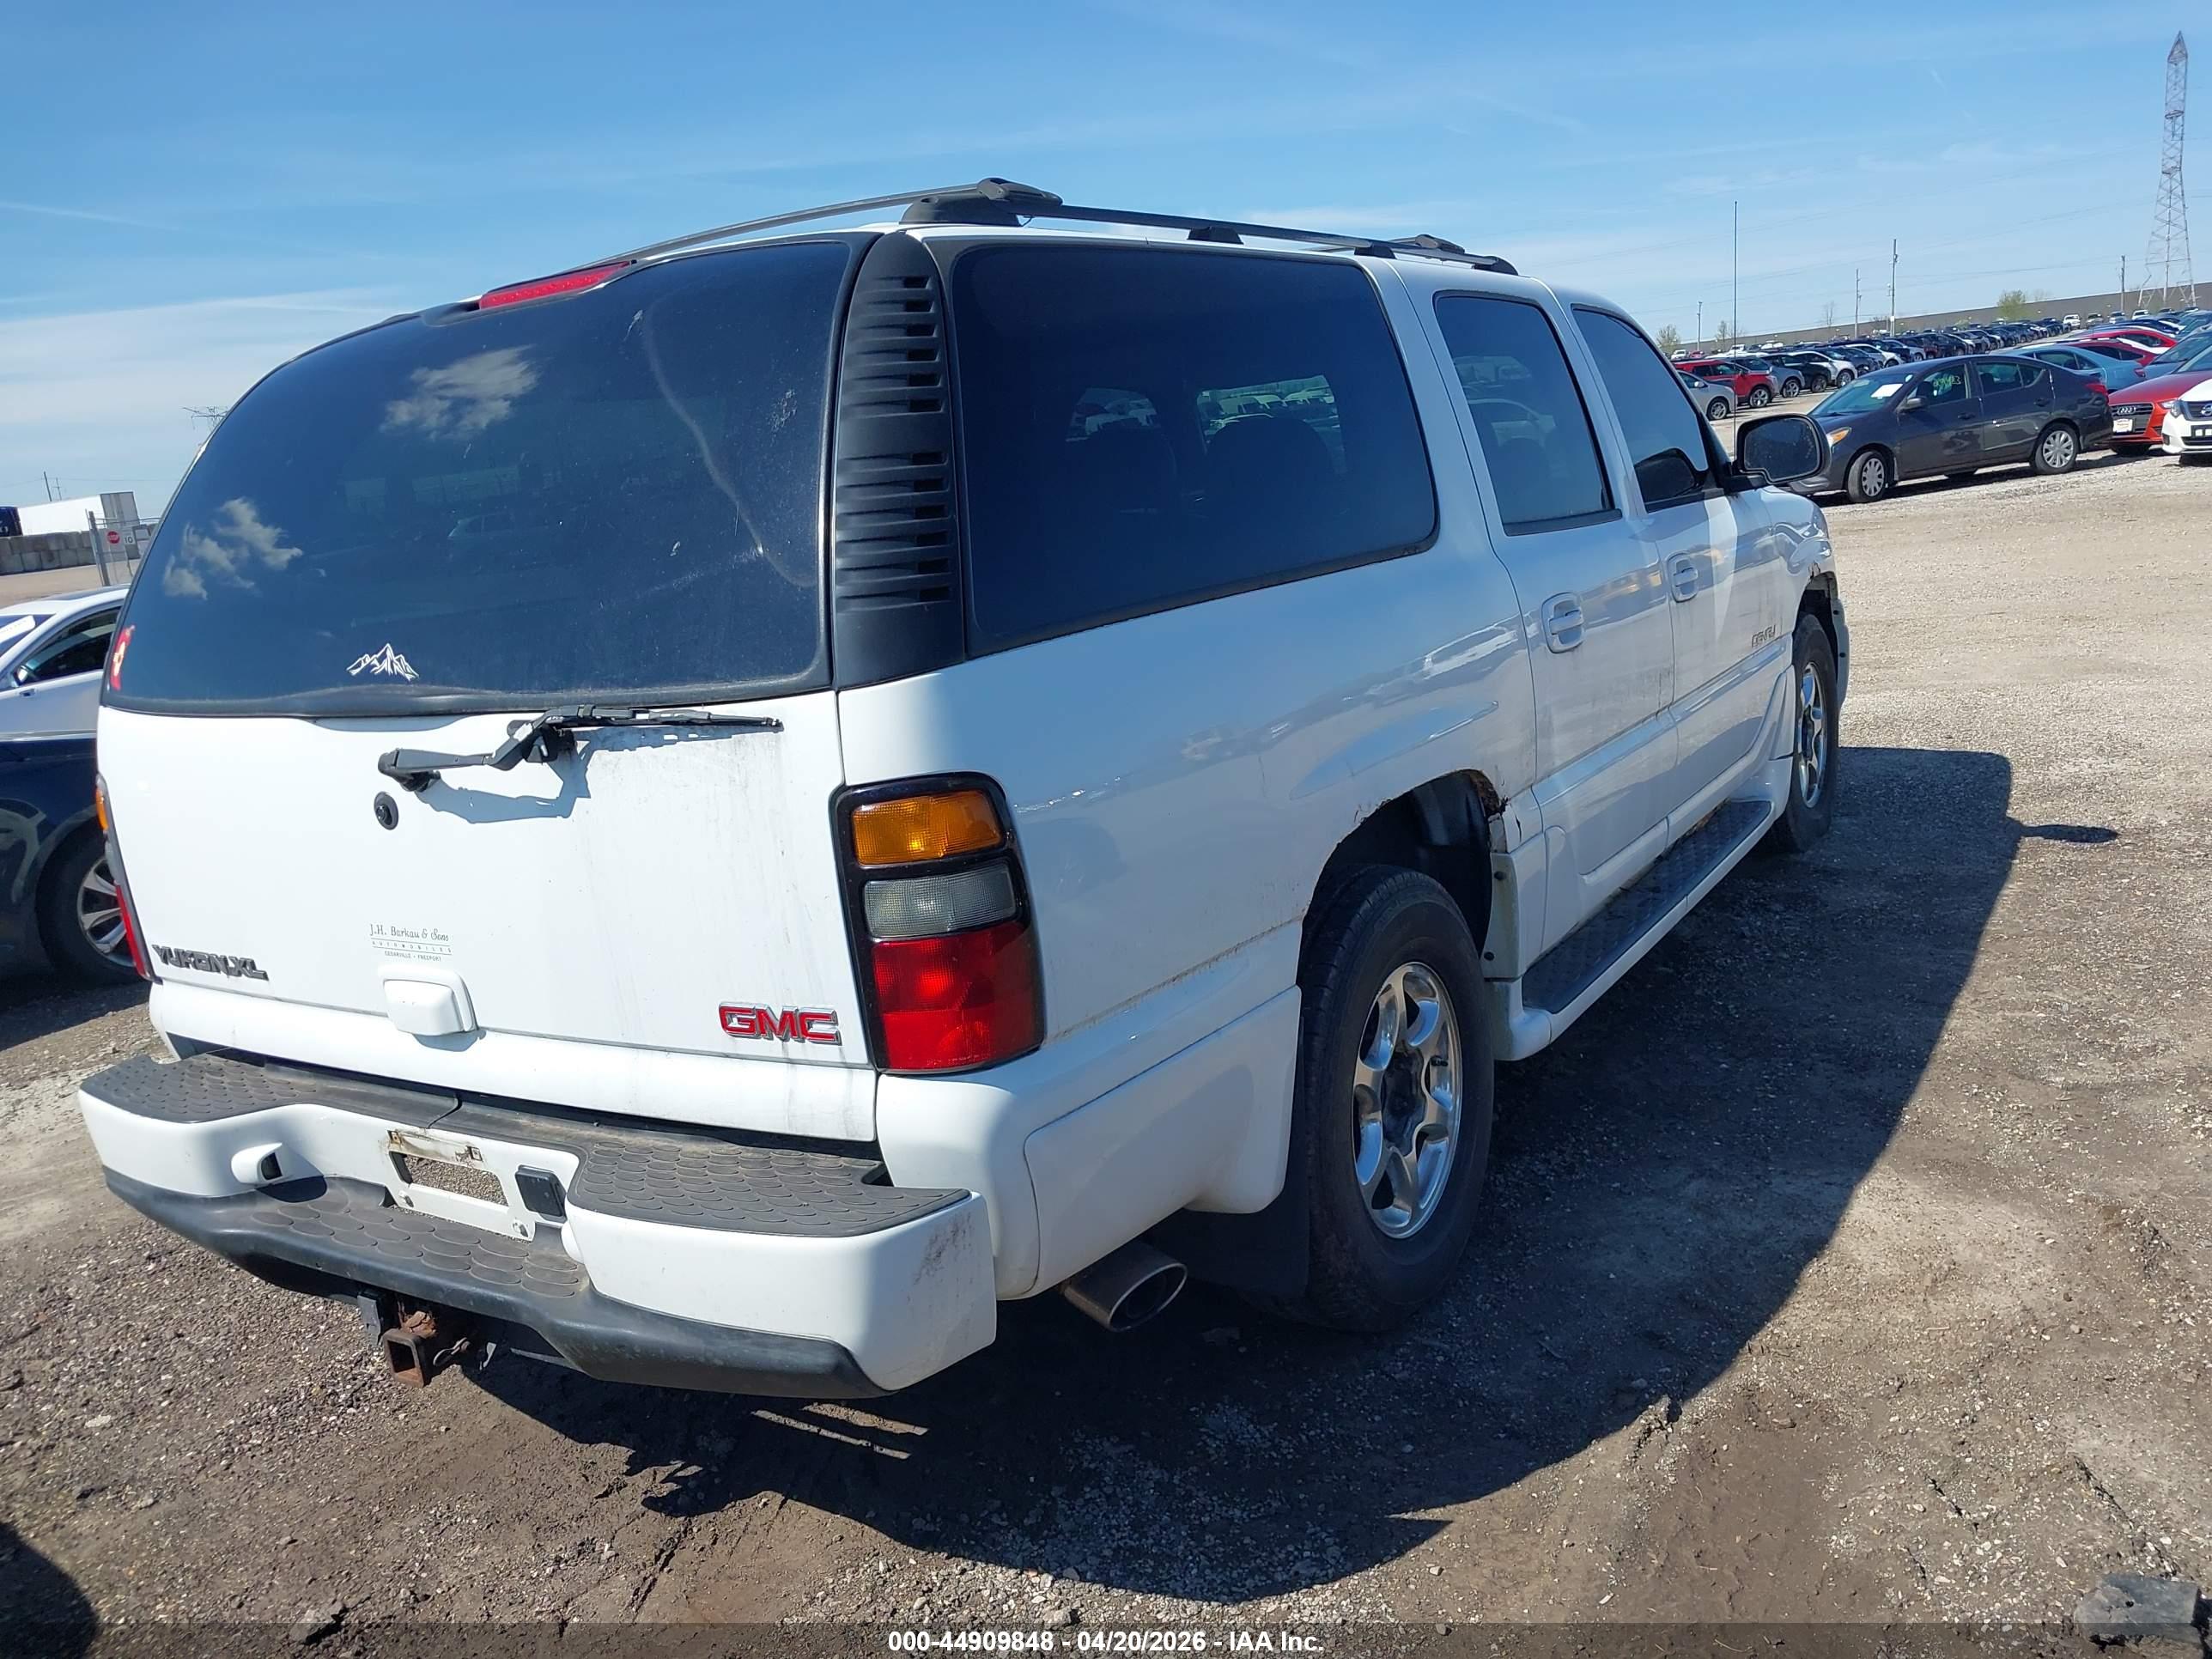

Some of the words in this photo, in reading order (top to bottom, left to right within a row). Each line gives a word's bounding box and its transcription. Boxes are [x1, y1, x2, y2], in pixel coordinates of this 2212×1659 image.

[370, 924, 386, 936] J.H.
[391, 926, 419, 939] Barkau
[422, 928, 428, 939] &
[430, 928, 448, 941] Sons
[151, 944, 228, 974] YUKON
[226, 956, 269, 981] XL
[718, 1001, 842, 1047] GMC
